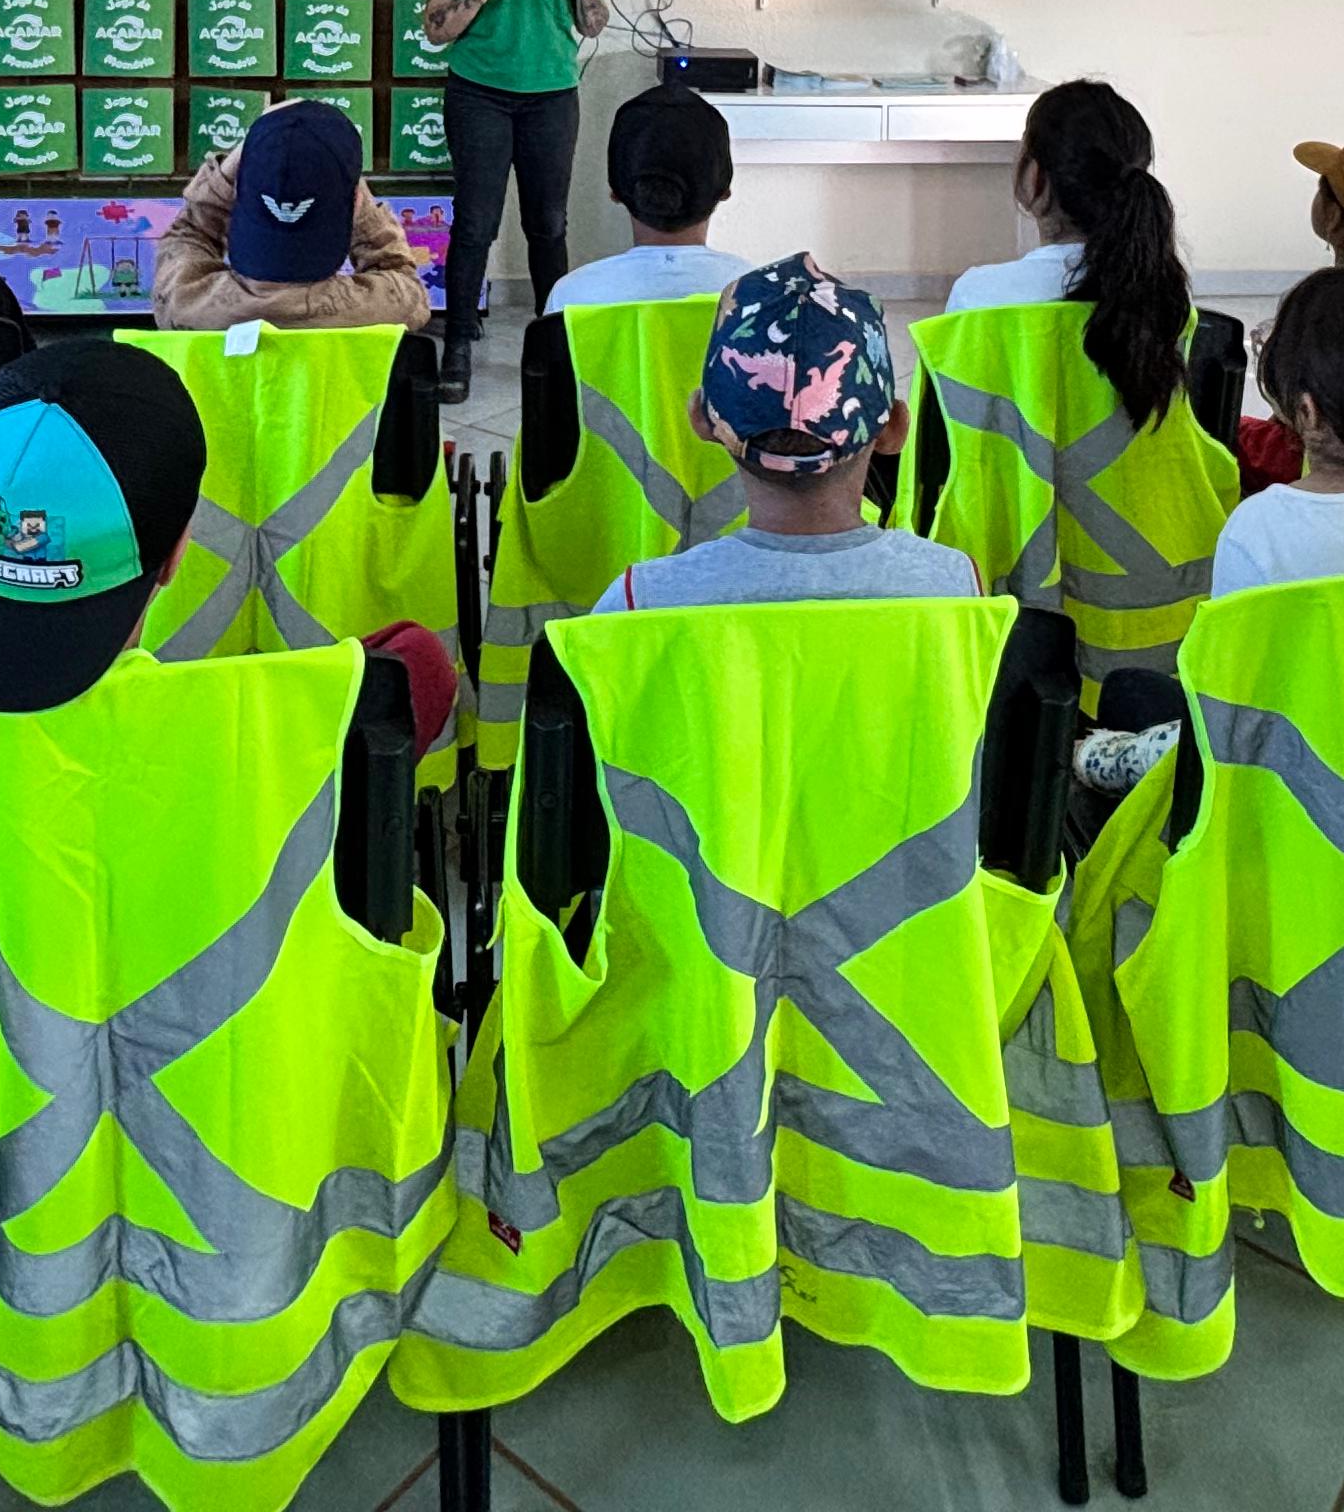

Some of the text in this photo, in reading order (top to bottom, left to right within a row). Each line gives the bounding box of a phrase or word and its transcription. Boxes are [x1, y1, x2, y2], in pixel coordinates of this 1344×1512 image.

[95, 27, 163, 40] ACAMAR
[199, 28, 264, 39] ACAMAR
[295, 32, 361, 44] ACAMAR
[94, 125, 161, 137] ACAMAR
[198, 124, 249, 139] ACAMA
